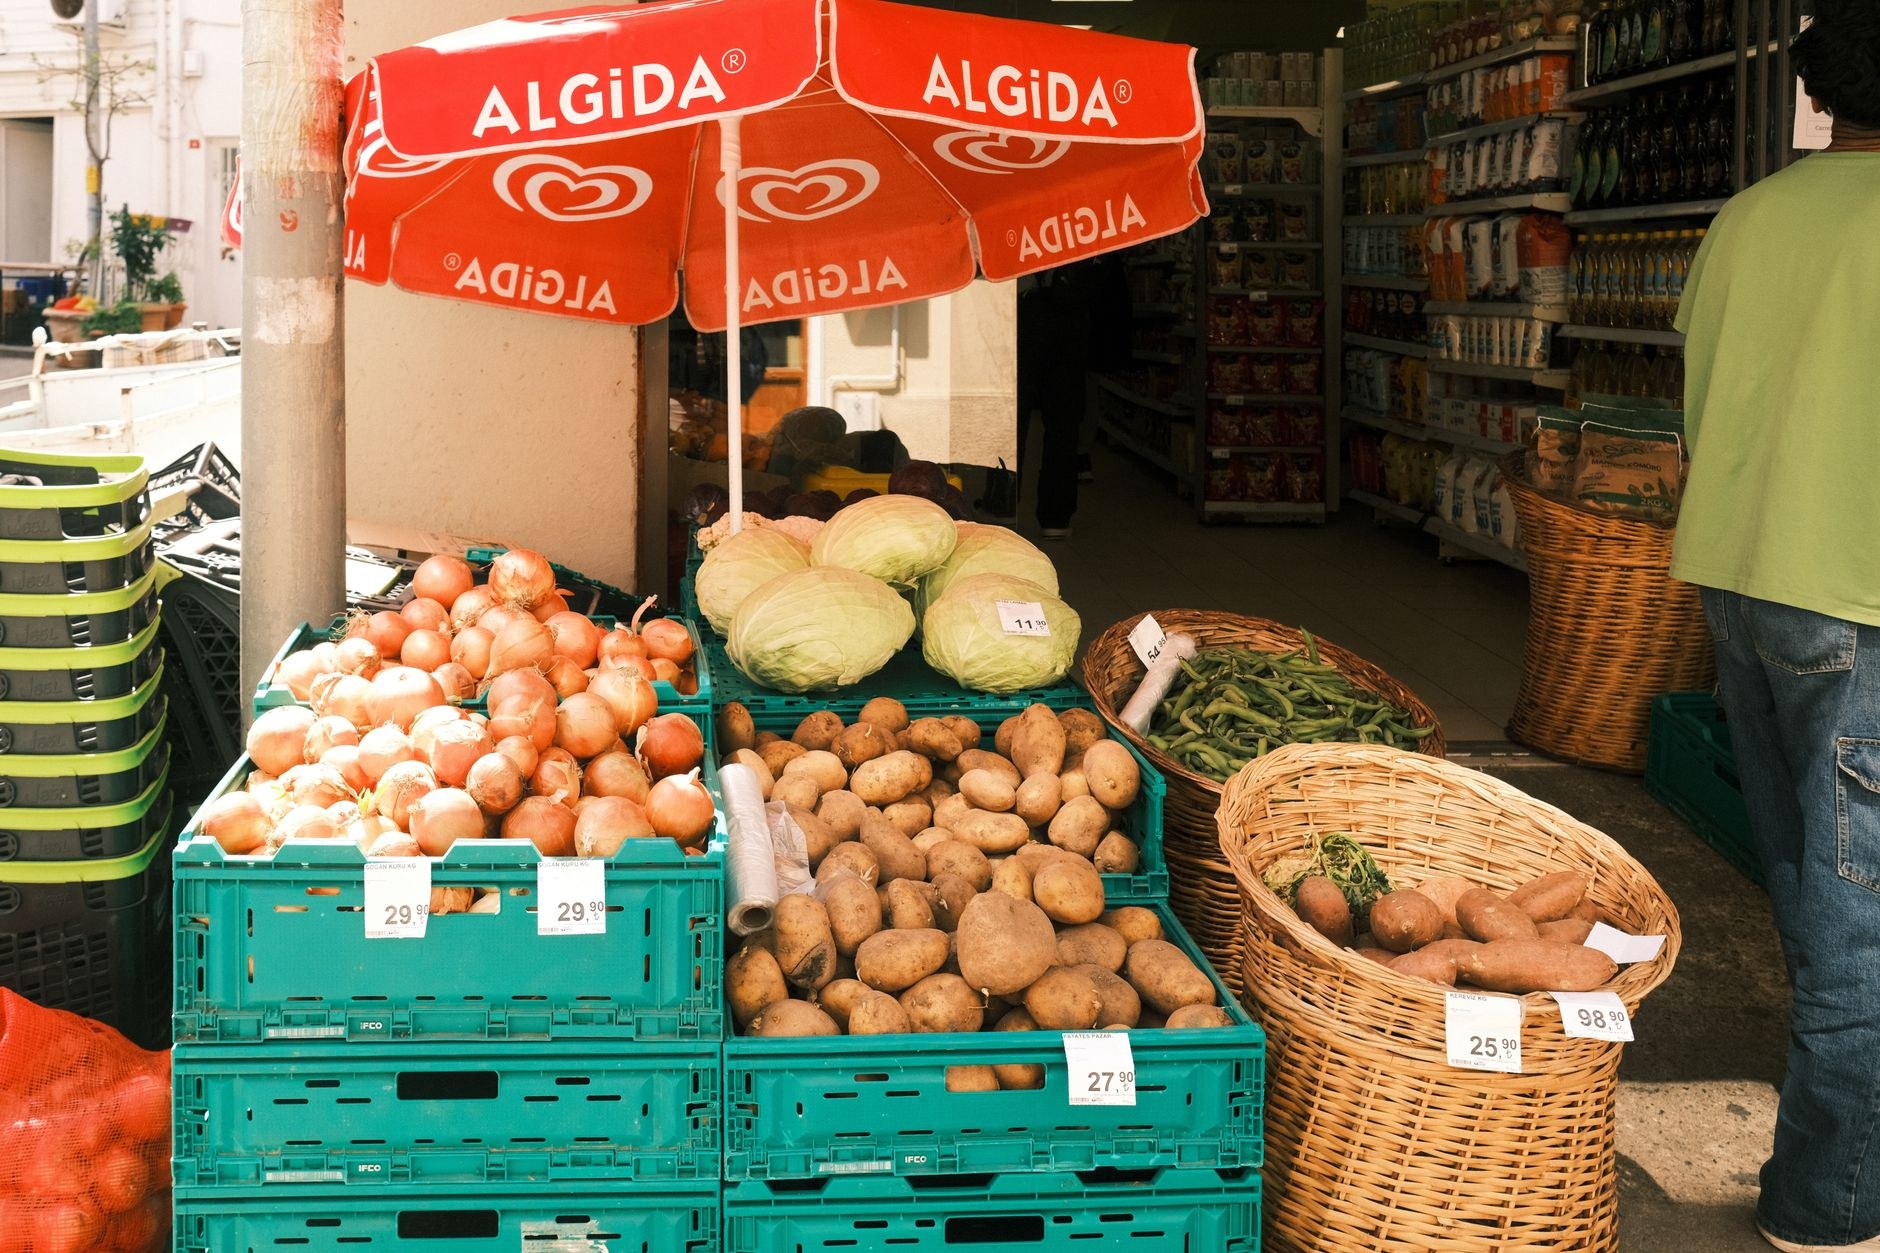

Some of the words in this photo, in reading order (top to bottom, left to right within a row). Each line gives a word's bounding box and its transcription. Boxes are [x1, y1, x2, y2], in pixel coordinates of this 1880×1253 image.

[922, 53, 1119, 129] ALGiDA
[472, 54, 726, 138] ALGiDA
[360, 1022, 383, 1030] IFCO
[904, 1155, 927, 1164] IFCO
[358, 1164, 382, 1172] IFCO
